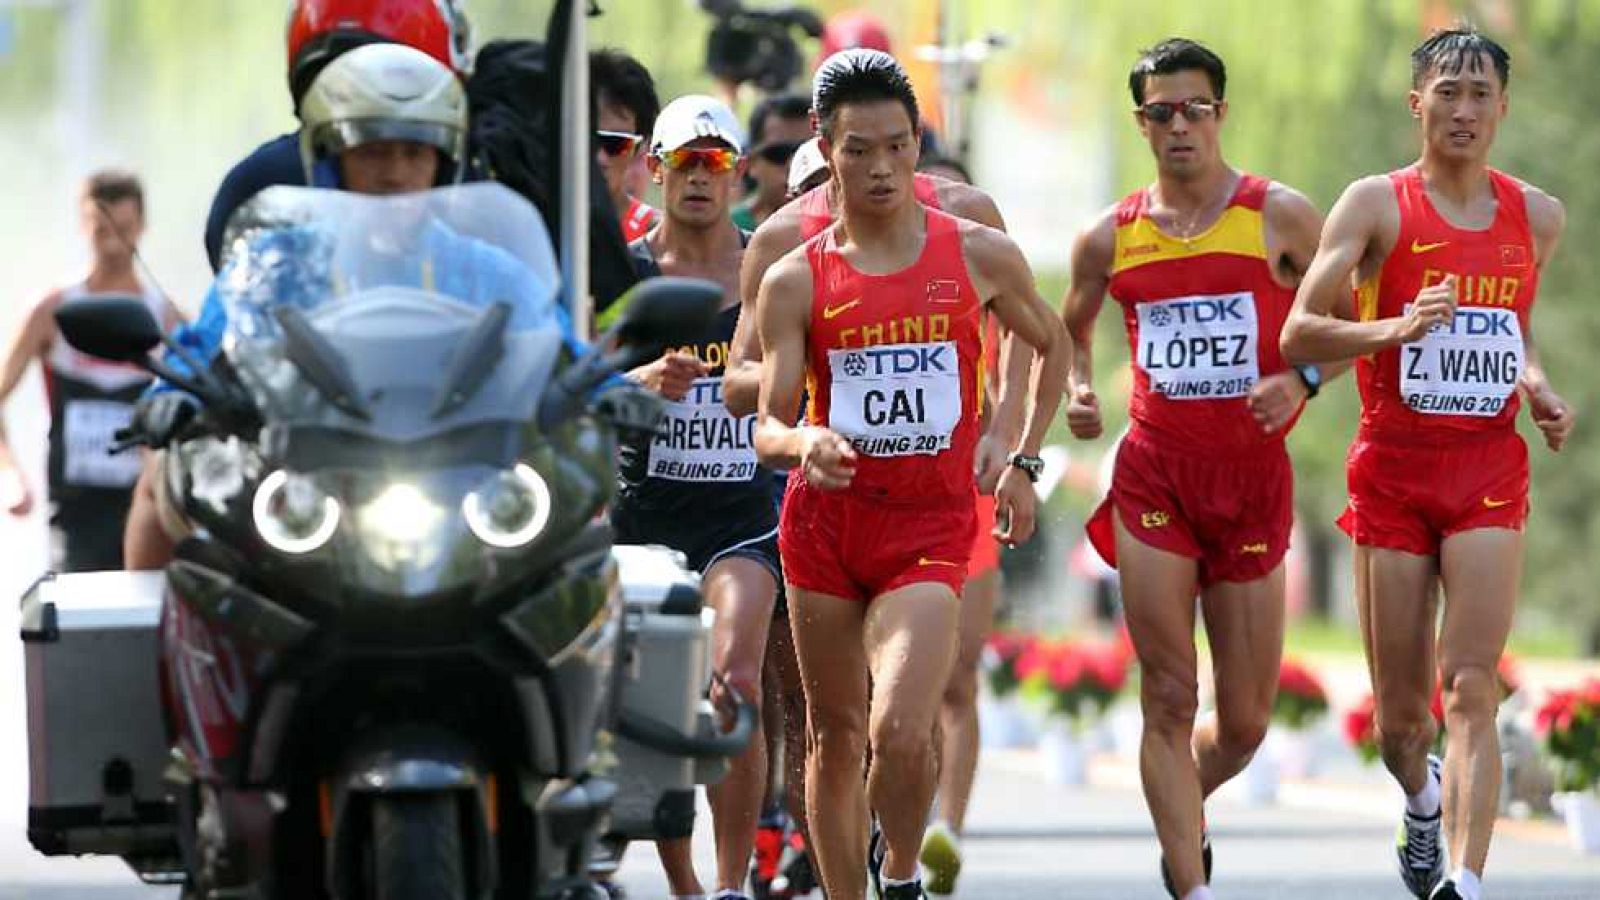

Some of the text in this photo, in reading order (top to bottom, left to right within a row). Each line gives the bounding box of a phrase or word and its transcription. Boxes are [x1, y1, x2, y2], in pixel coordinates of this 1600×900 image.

[1170, 298, 1243, 324] TDK
[1449, 312, 1513, 336] TDK
[865, 345, 947, 376] TDK
[1146, 332, 1248, 369] LÓPEZ
[1407, 347, 1517, 384] Z. WANG
[863, 388, 926, 427] CAI
[1408, 393, 1477, 412] BEIJING
[655, 460, 722, 478] BEIJING
